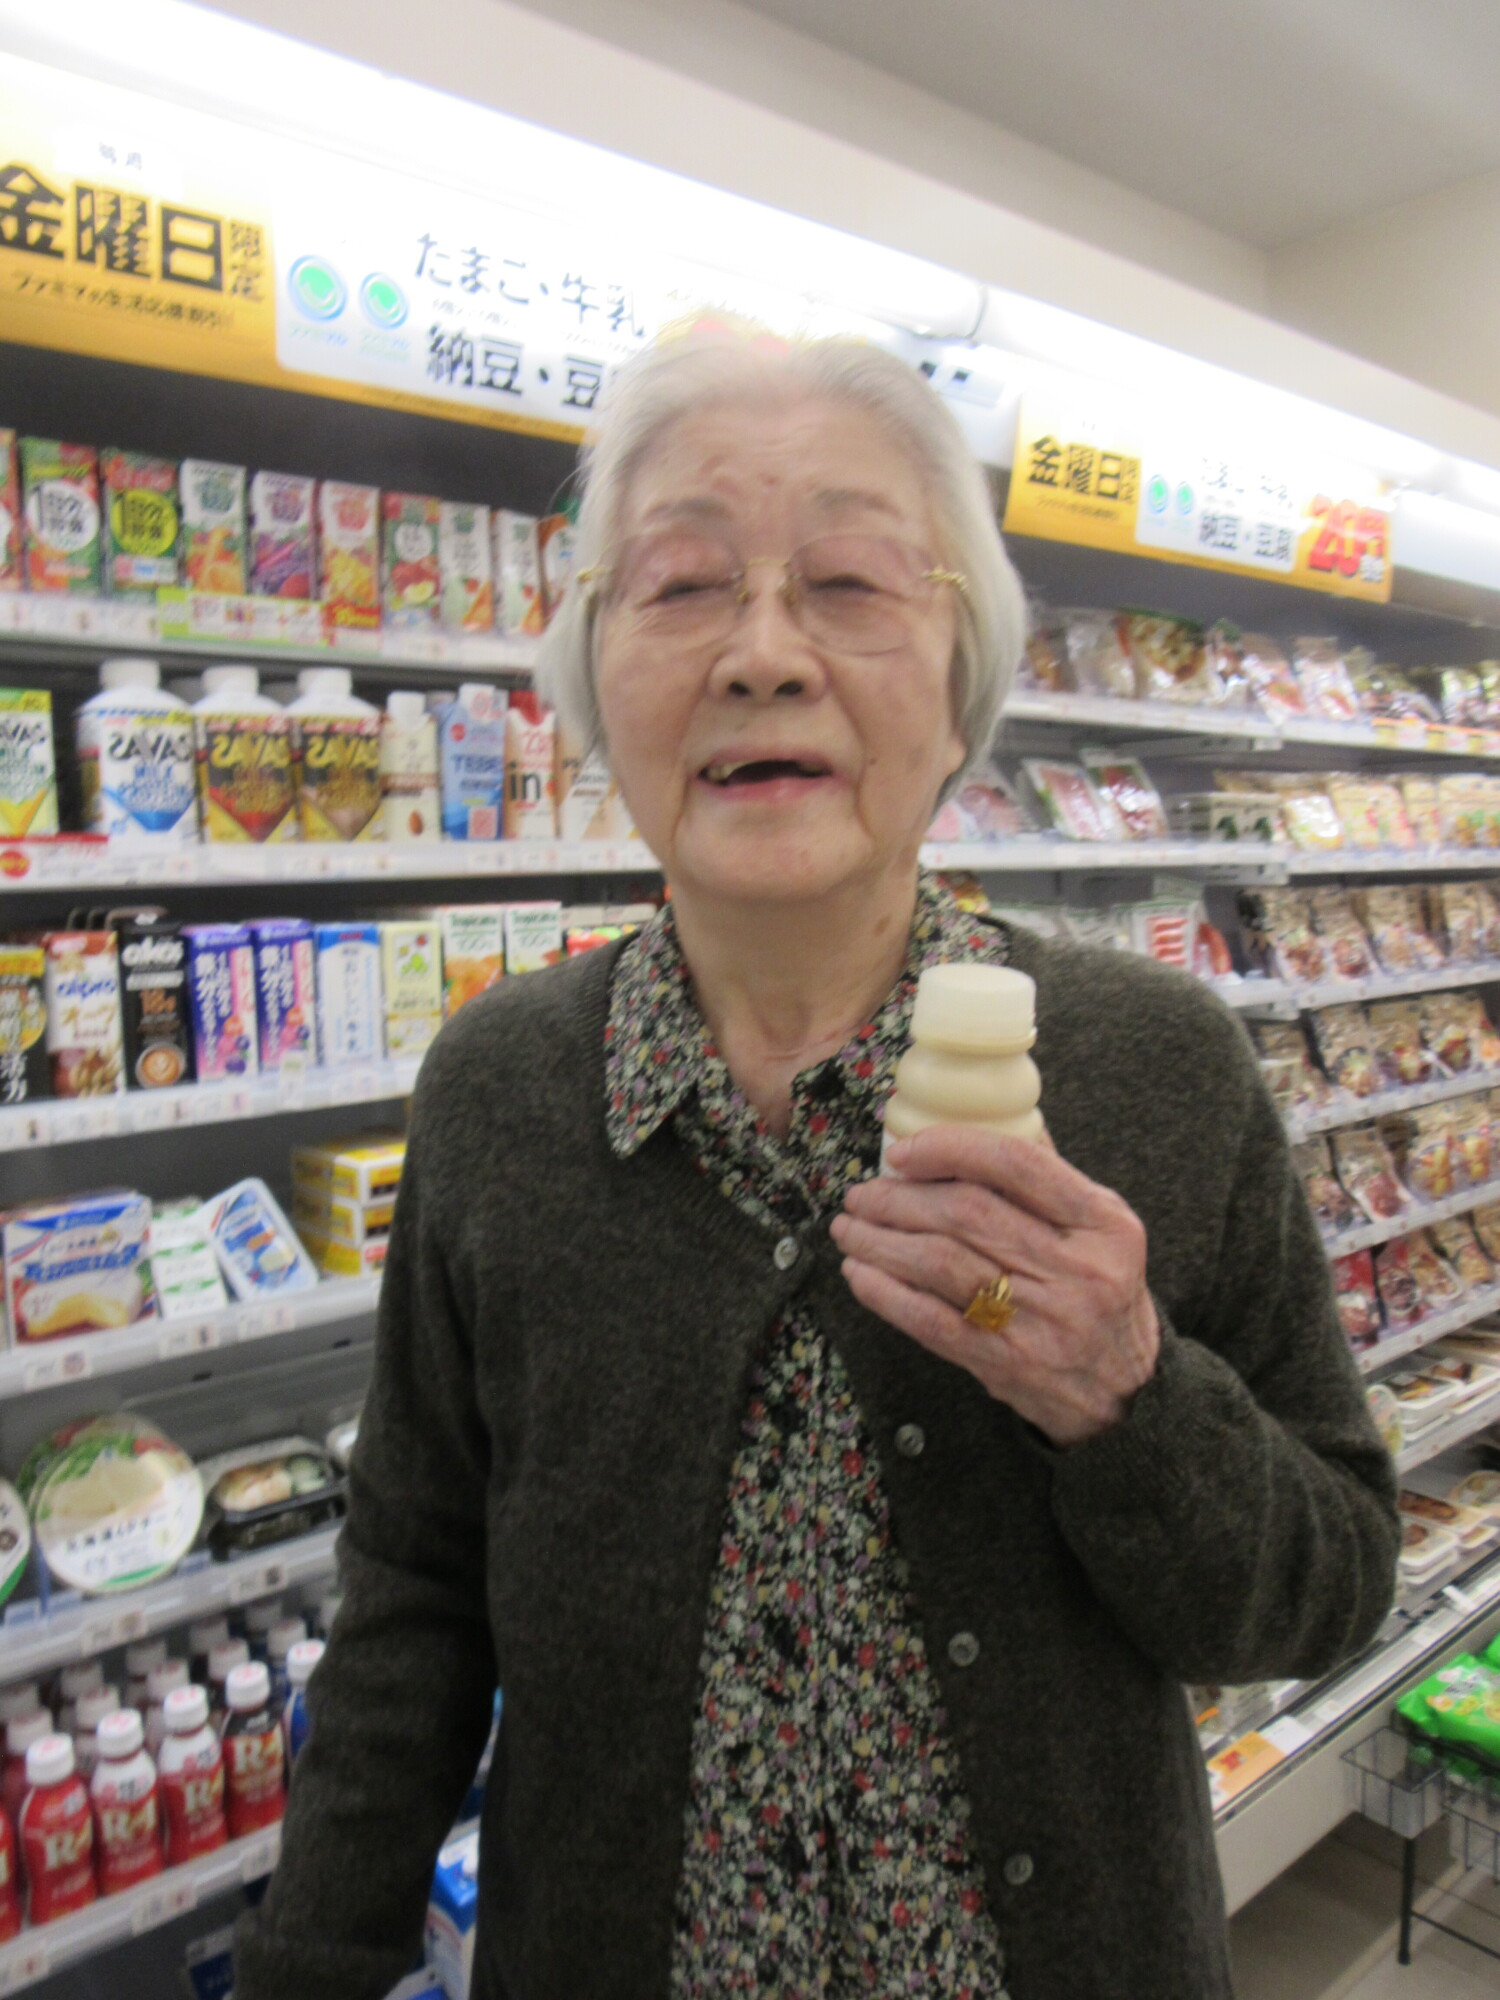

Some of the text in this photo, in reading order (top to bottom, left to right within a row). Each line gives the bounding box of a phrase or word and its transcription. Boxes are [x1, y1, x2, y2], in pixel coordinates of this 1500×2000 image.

[0, 164, 224, 292] 金曜日
[426, 322, 616, 409] 納豆・豆
[1028, 436, 1122, 500] 金曜日
